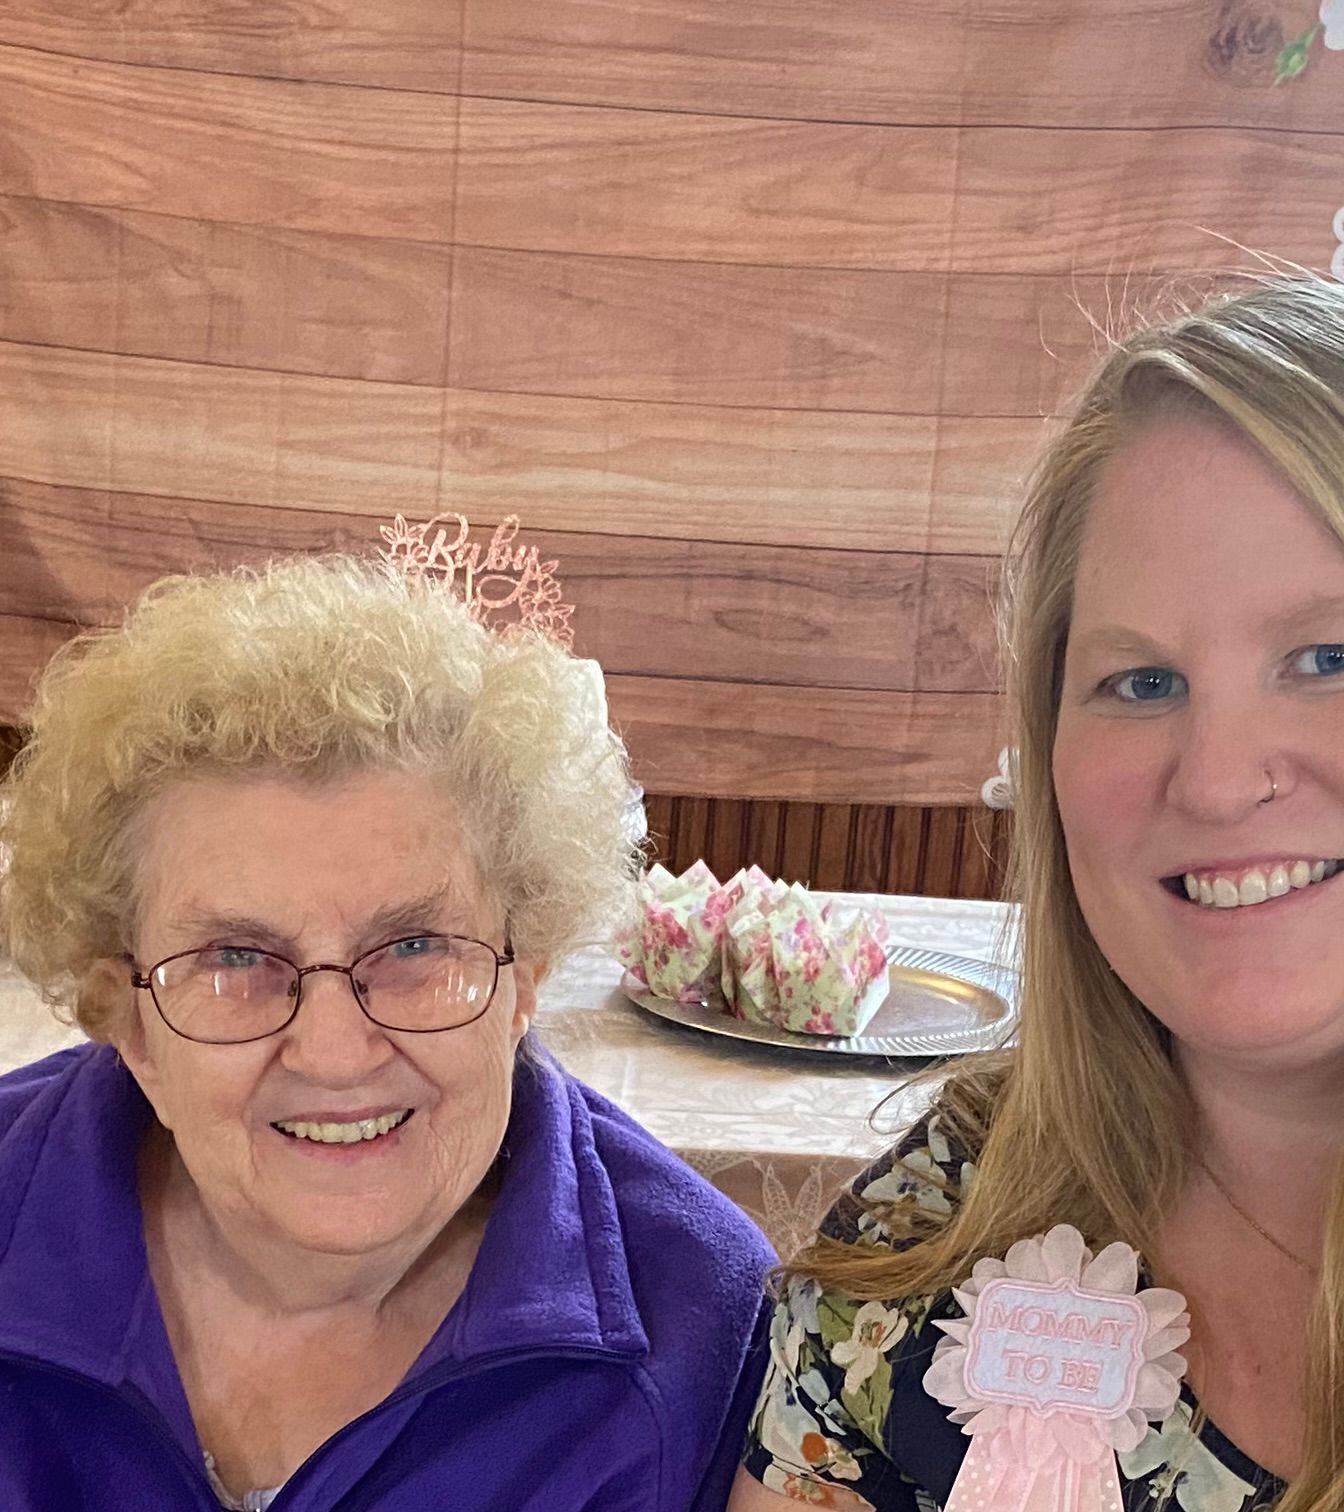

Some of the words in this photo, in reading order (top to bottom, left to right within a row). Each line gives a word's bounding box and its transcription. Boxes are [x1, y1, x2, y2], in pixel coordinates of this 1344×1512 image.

[983, 1303, 1134, 1349] MOMMY
[1003, 1351, 1051, 1385] TO
[1057, 1359, 1103, 1393] BE
